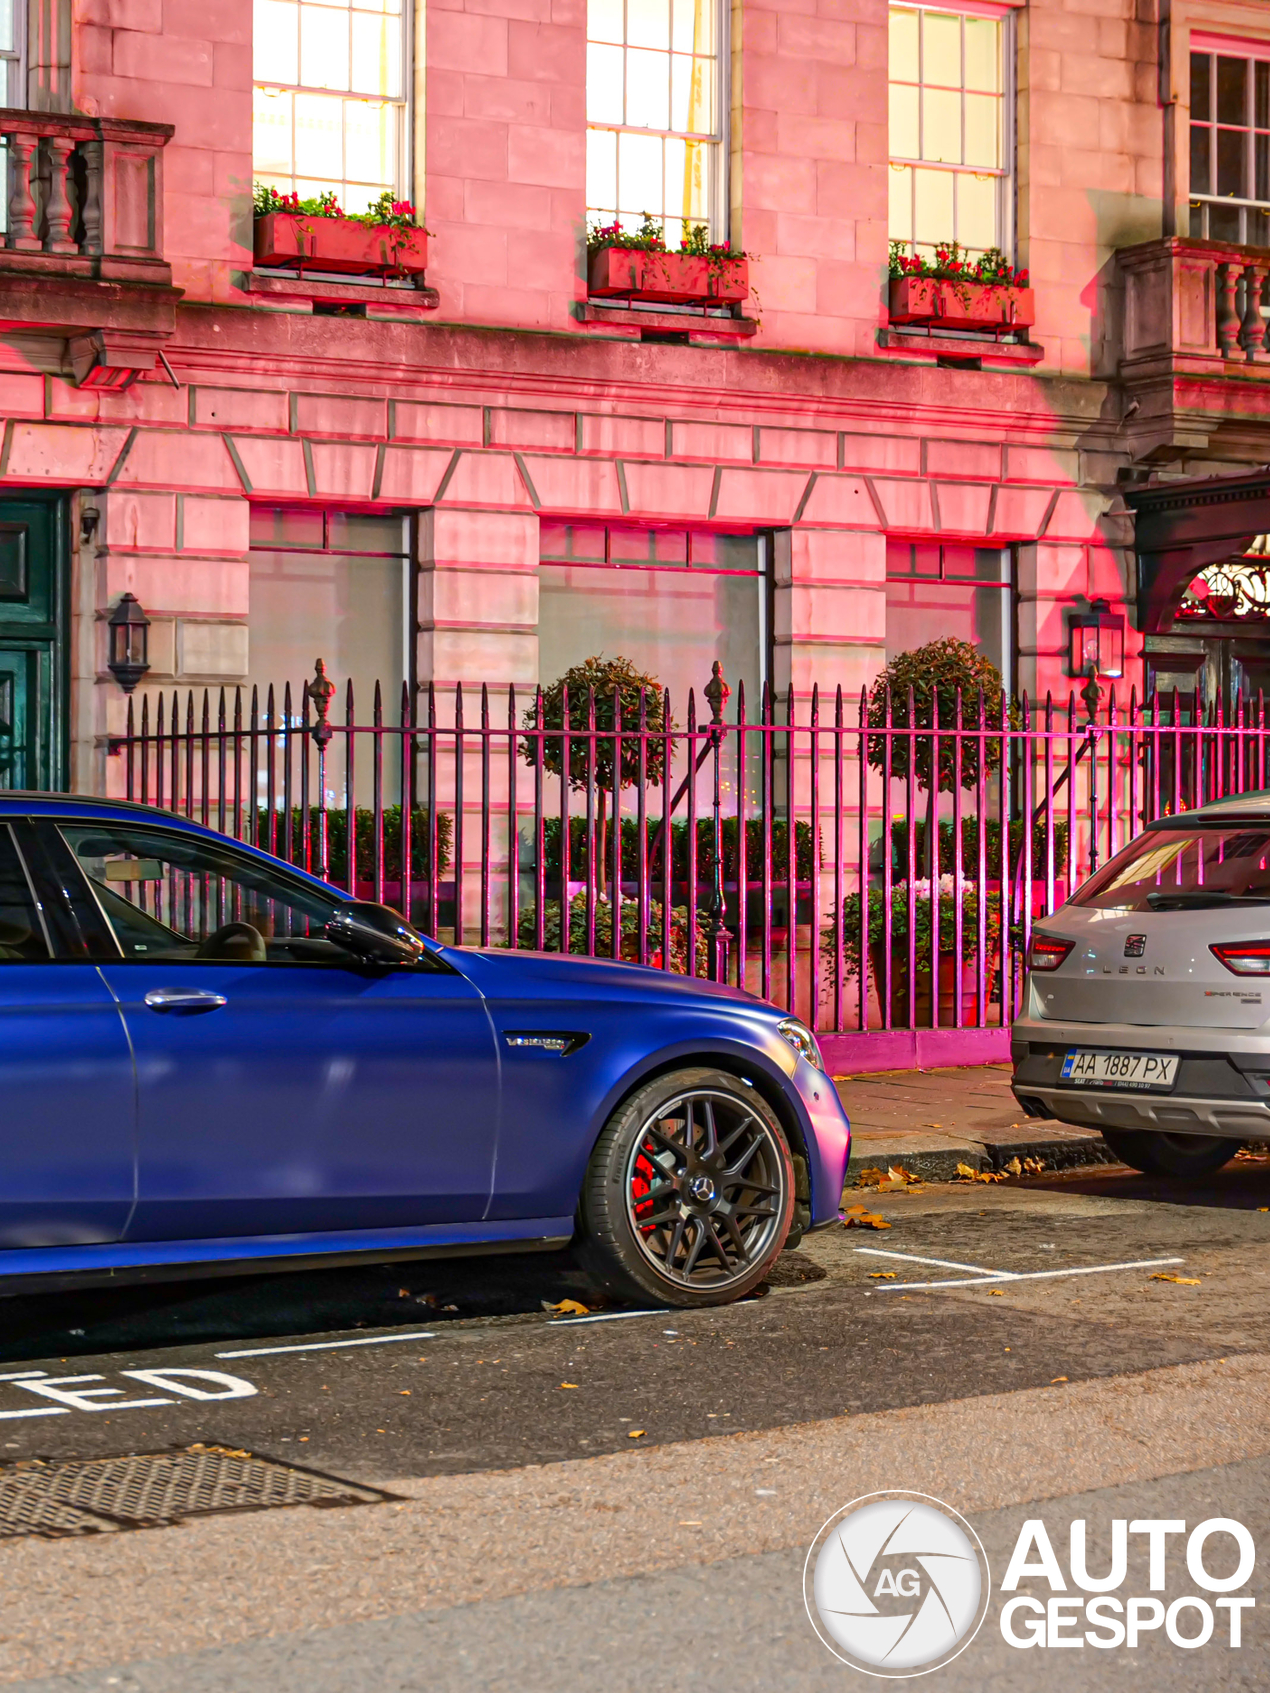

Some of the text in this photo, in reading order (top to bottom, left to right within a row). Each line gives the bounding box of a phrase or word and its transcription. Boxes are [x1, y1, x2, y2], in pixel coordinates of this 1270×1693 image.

[1102, 964, 1166, 976] LEON
[1074, 1053, 1172, 1080] AA 1887 PX
